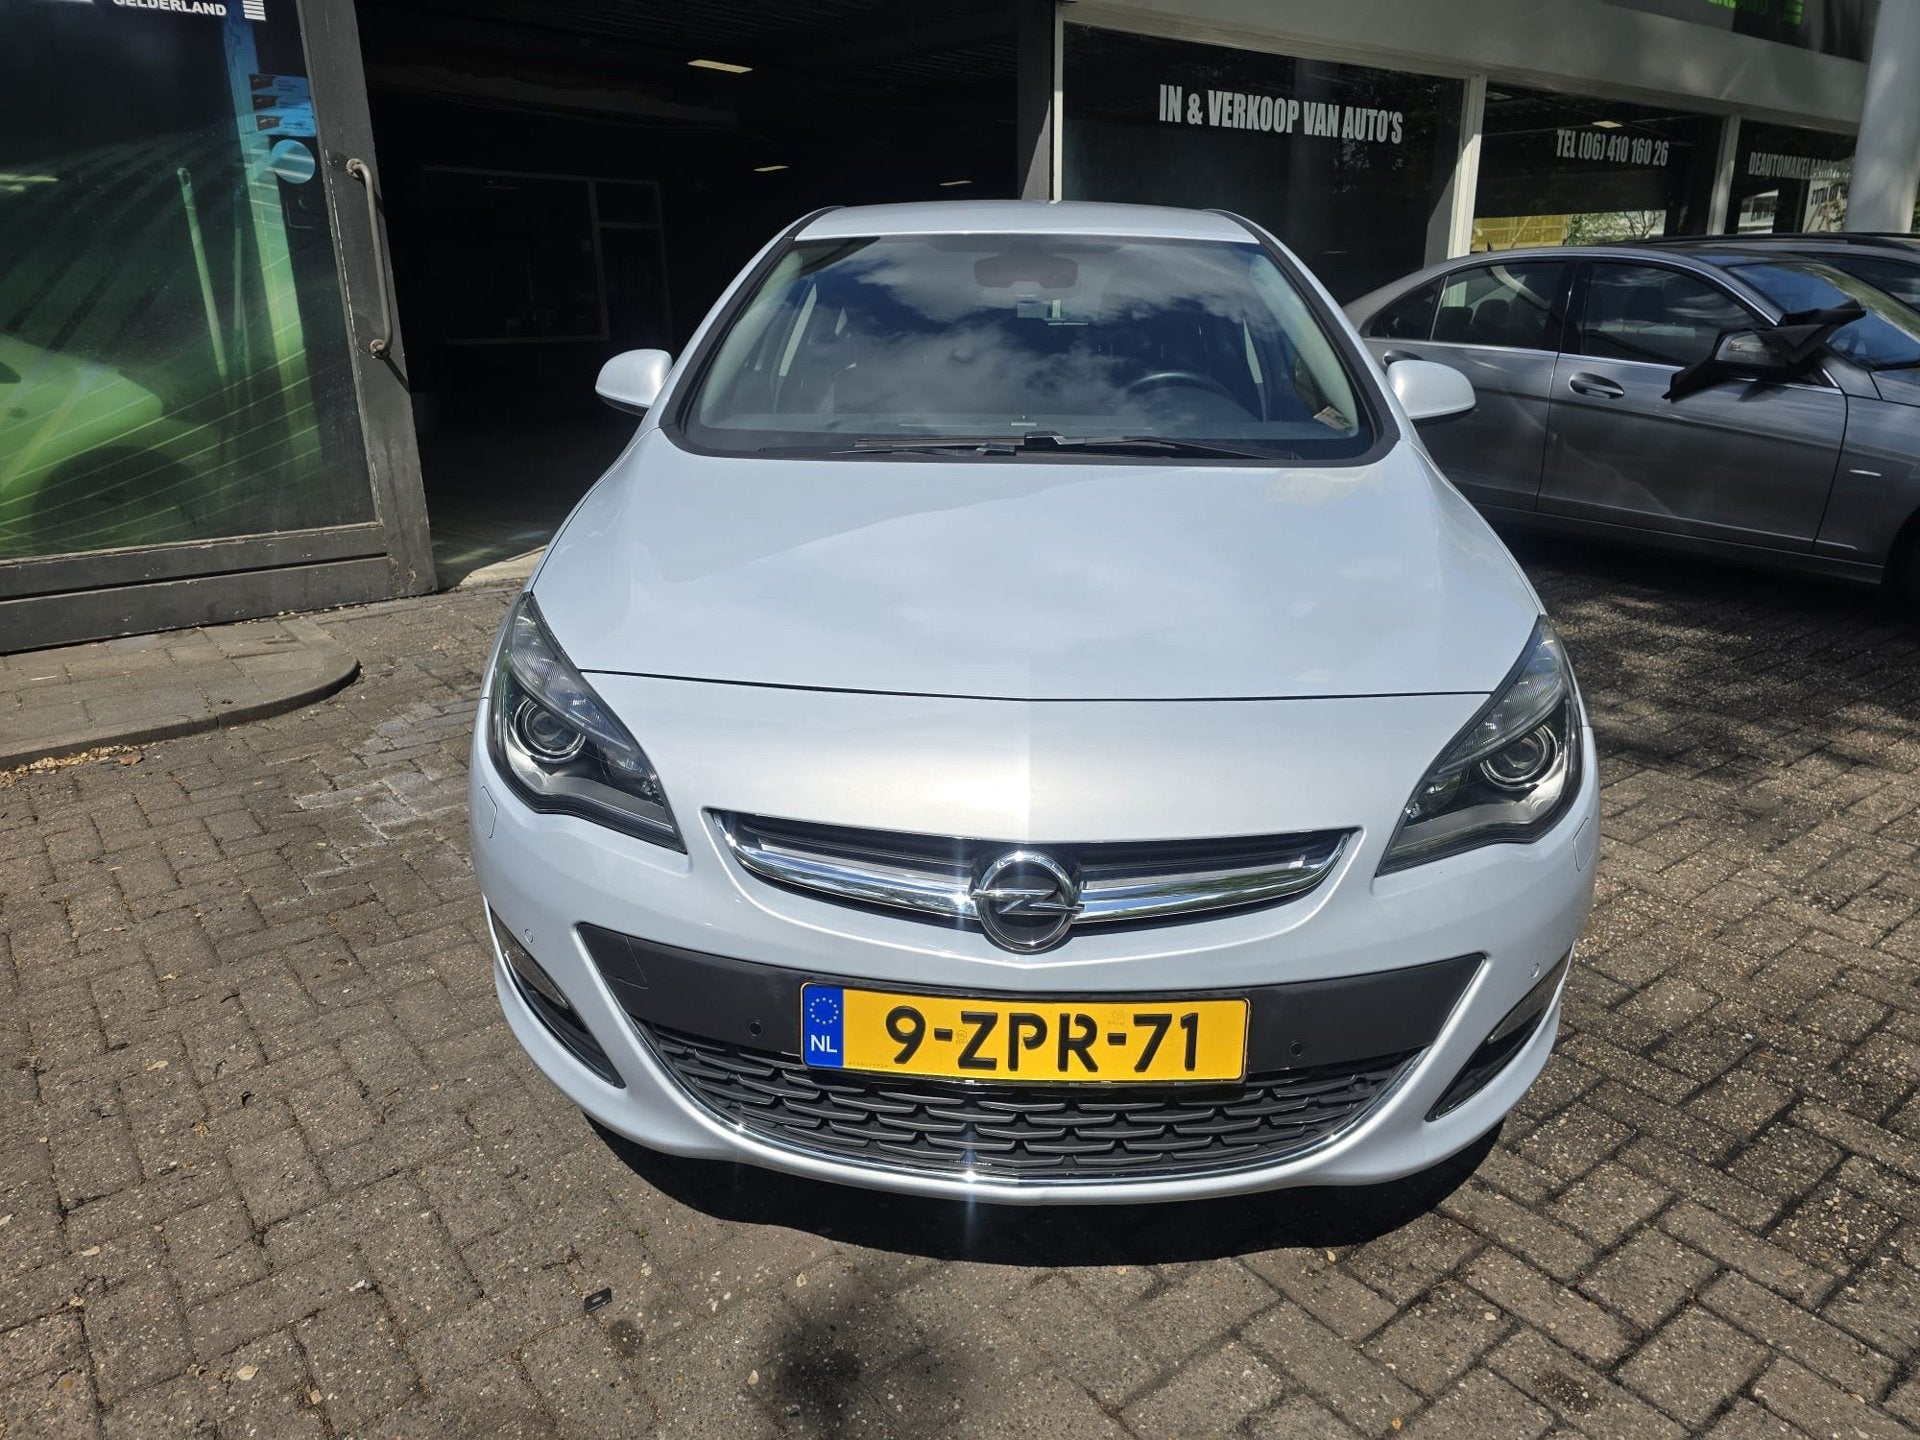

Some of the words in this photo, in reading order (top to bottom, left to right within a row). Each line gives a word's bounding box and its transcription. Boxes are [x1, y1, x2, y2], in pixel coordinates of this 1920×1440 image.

[1159, 84, 1183, 123] IN
[1187, 93, 1204, 125] &
[1207, 89, 1300, 134] VERKOOP
[1302, 101, 1340, 138] VAN
[1341, 106, 1403, 144] AUTO'S
[1556, 129, 1577, 158] TEL
[1578, 132, 1607, 160] (06)
[1607, 135, 1630, 163] 410
[1631, 137, 1652, 165] 160
[1652, 140, 1670, 167] 26
[810, 1034, 838, 1054] NL
[885, 1005, 1199, 1073] 9-ZPR-71
